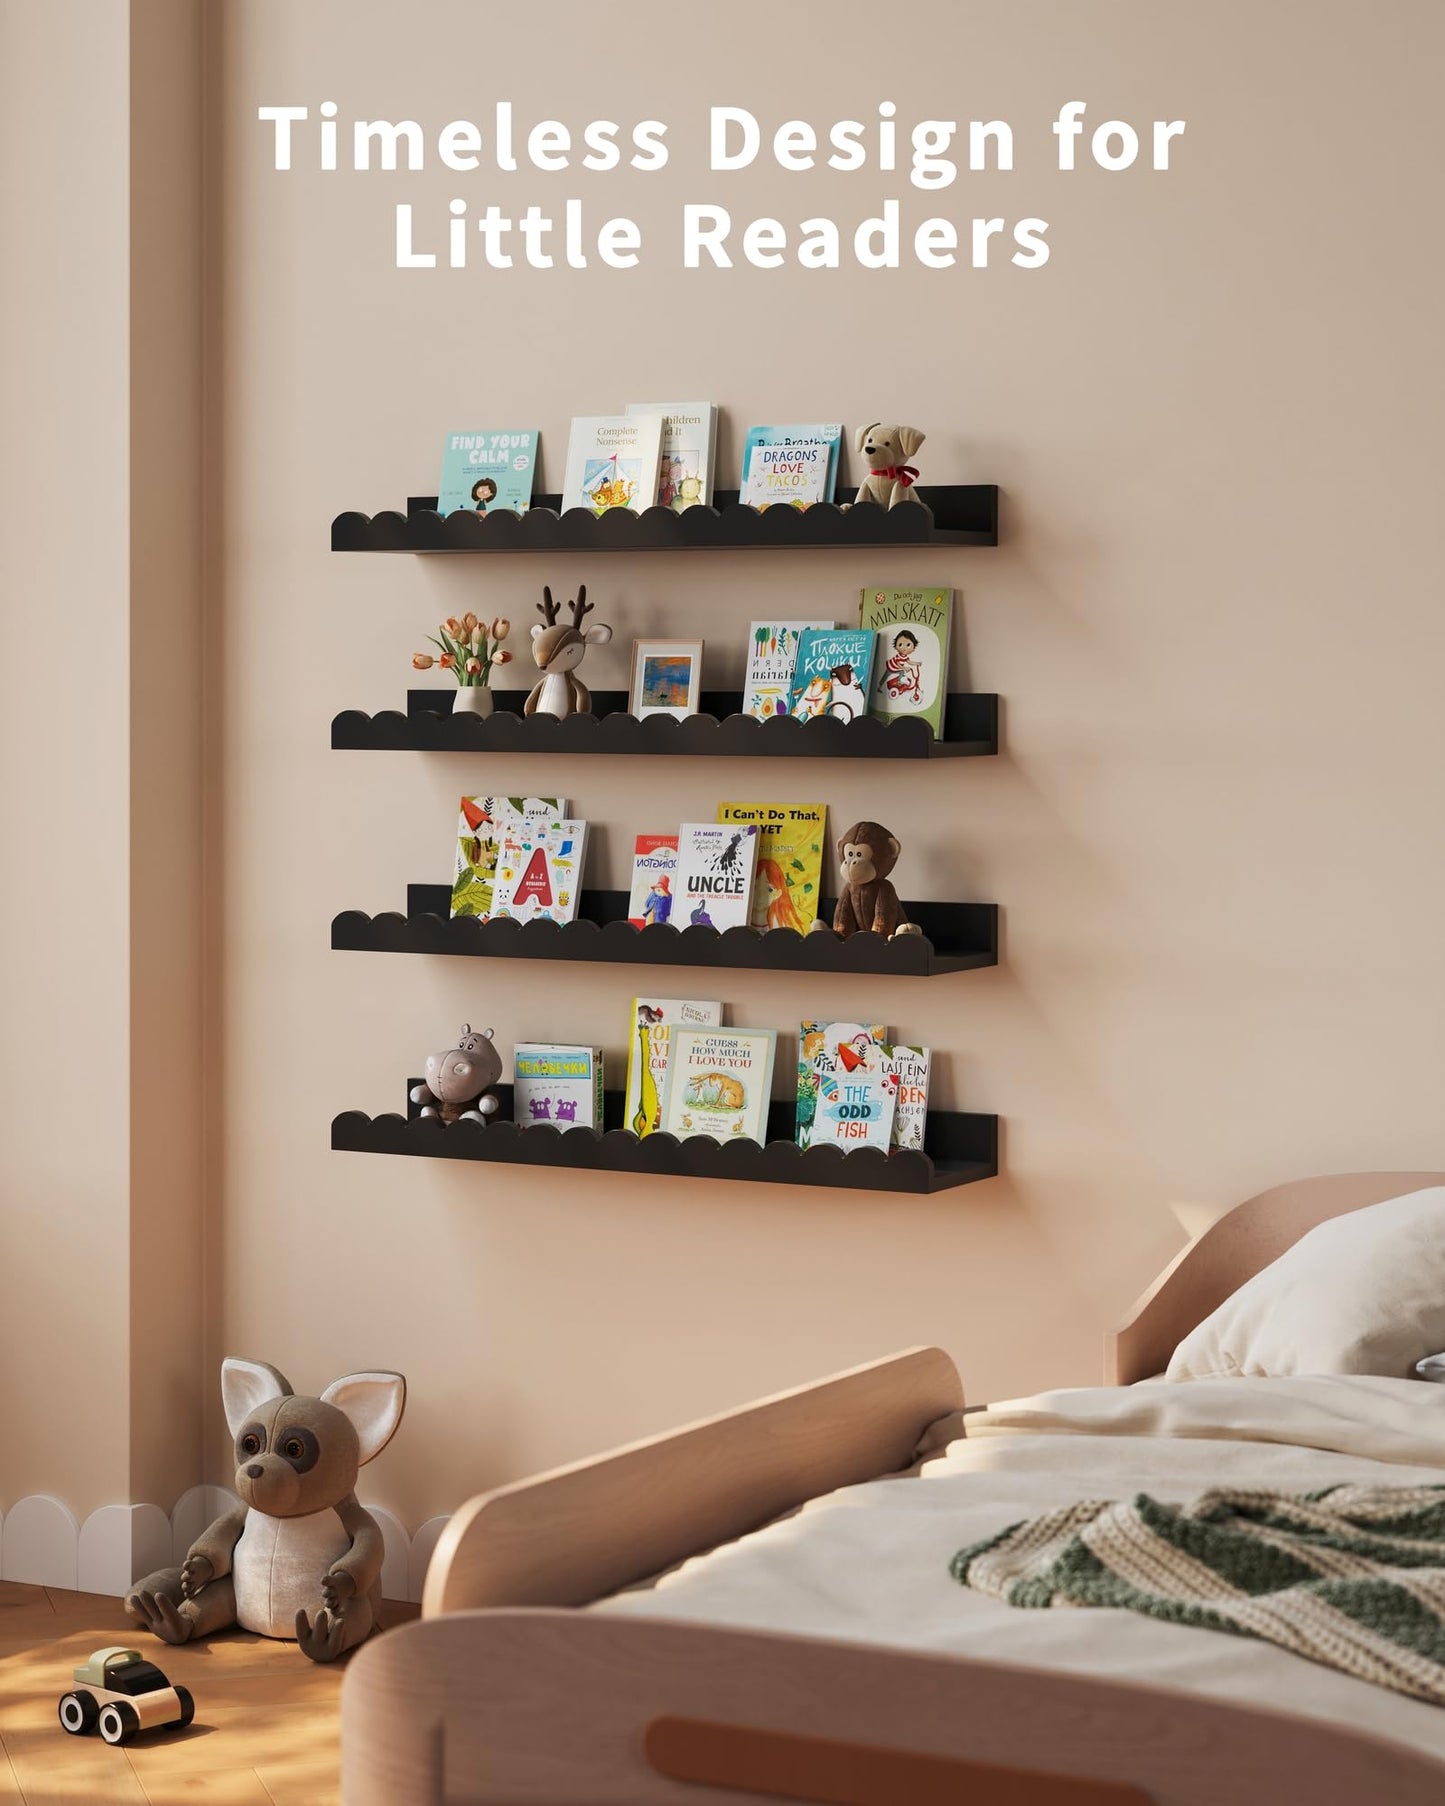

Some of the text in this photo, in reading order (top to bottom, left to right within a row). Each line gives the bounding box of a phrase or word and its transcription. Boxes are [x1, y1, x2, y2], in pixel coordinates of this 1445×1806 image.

[597, 426, 639, 437] Complete
[451, 433, 530, 450] FIND YOUR
[596, 437, 637, 447] Nonsense
[469, 449, 510, 464] CALM
[763, 450, 818, 463] DRAGONS
[773, 463, 804, 474] LOVE
[767, 474, 809, 488] TACOS
[870, 602, 945, 630] MIN SKATT
[725, 809, 820, 821] I Can't Do That,
[759, 825, 783, 834] YET
[687, 876, 745, 894] UNCLE
[706, 1038, 739, 1048] GUESS
[692, 1046, 751, 1058] HOW MUCH
[688, 1056, 752, 1068] I LOVE YOU
[908, 1063, 928, 1077] EIN
[845, 1085, 872, 1102] THE
[838, 1104, 872, 1119] ODD
[836, 1121, 868, 1139] FISH
